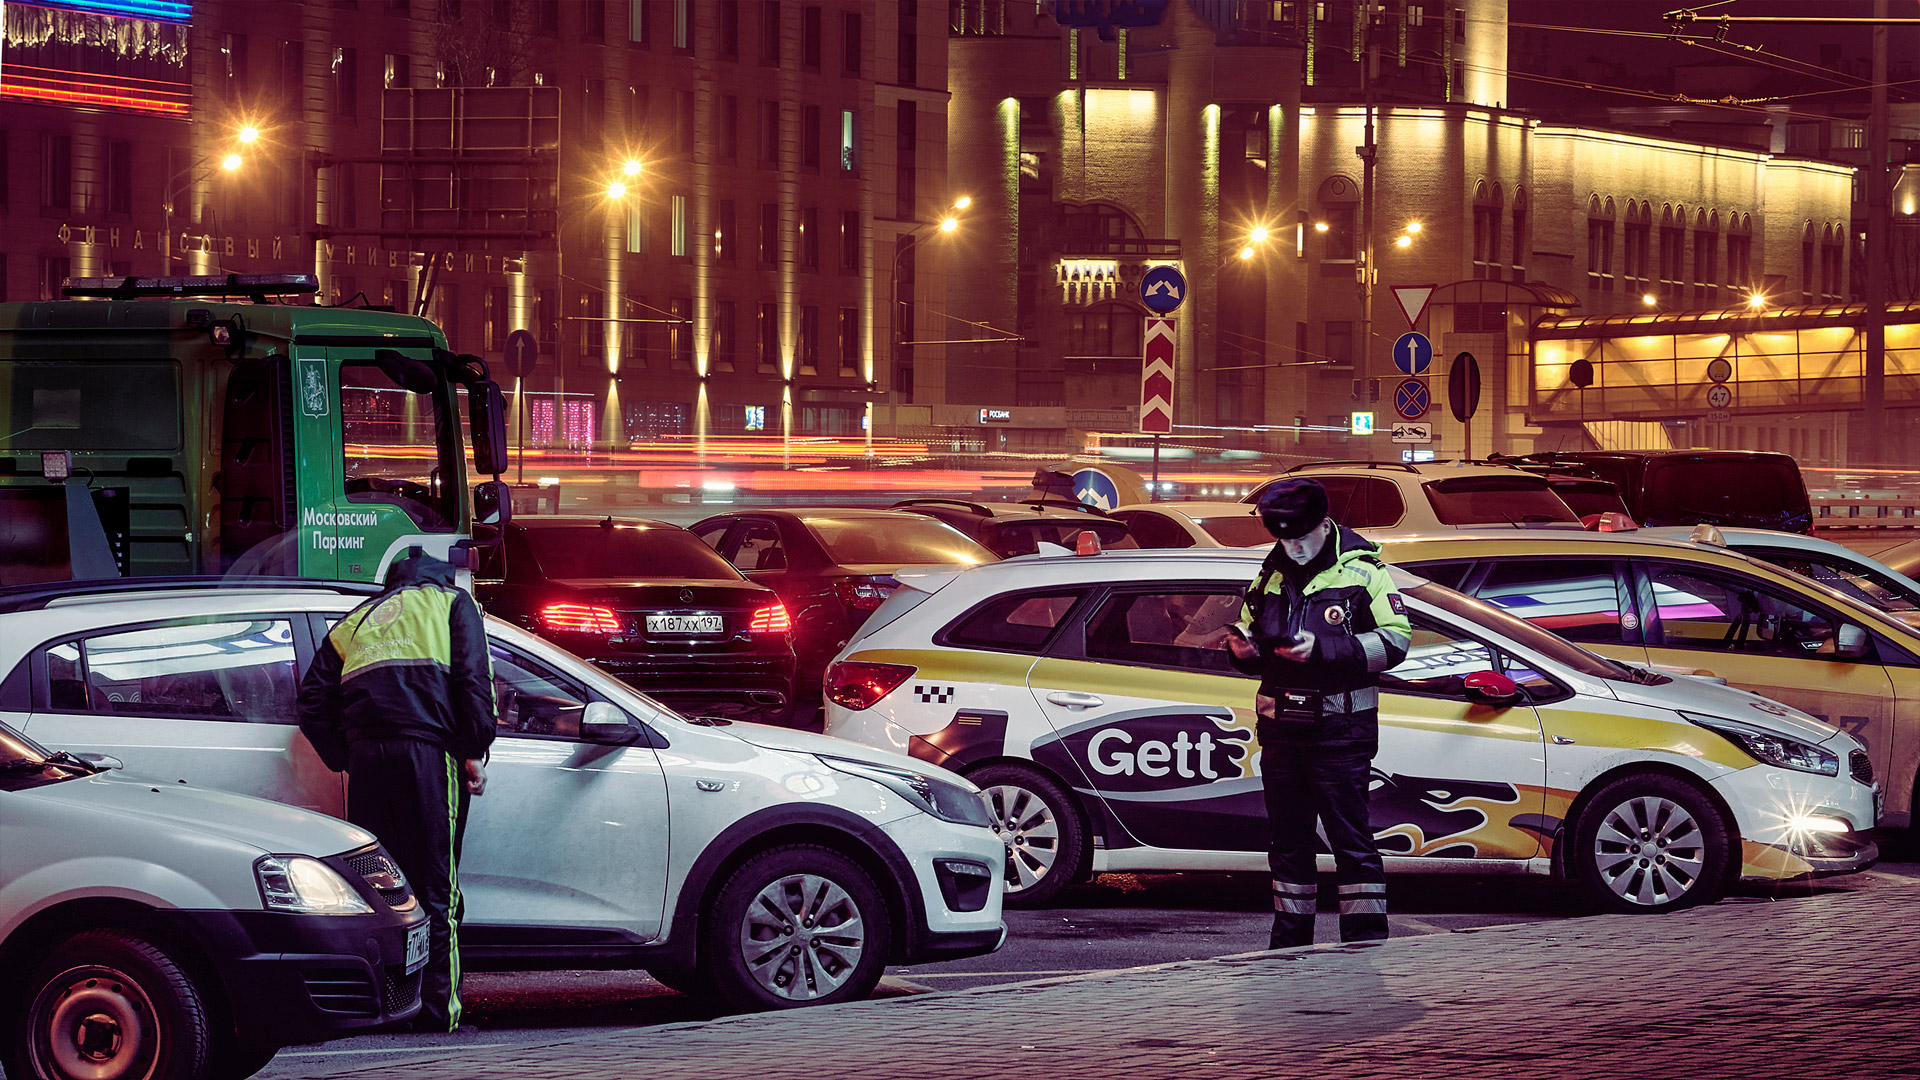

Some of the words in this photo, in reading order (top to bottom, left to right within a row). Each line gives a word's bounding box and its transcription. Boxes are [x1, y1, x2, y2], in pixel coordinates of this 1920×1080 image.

[325, 243, 527, 275] УНИВЕСИТЕ
[989, 410, 1010, 419] РОСБАНК
[304, 507, 377, 526] Московский
[313, 530, 365, 555] Паркинг
[701, 616, 719, 628] 197
[1087, 728, 1219, 779] Gett
